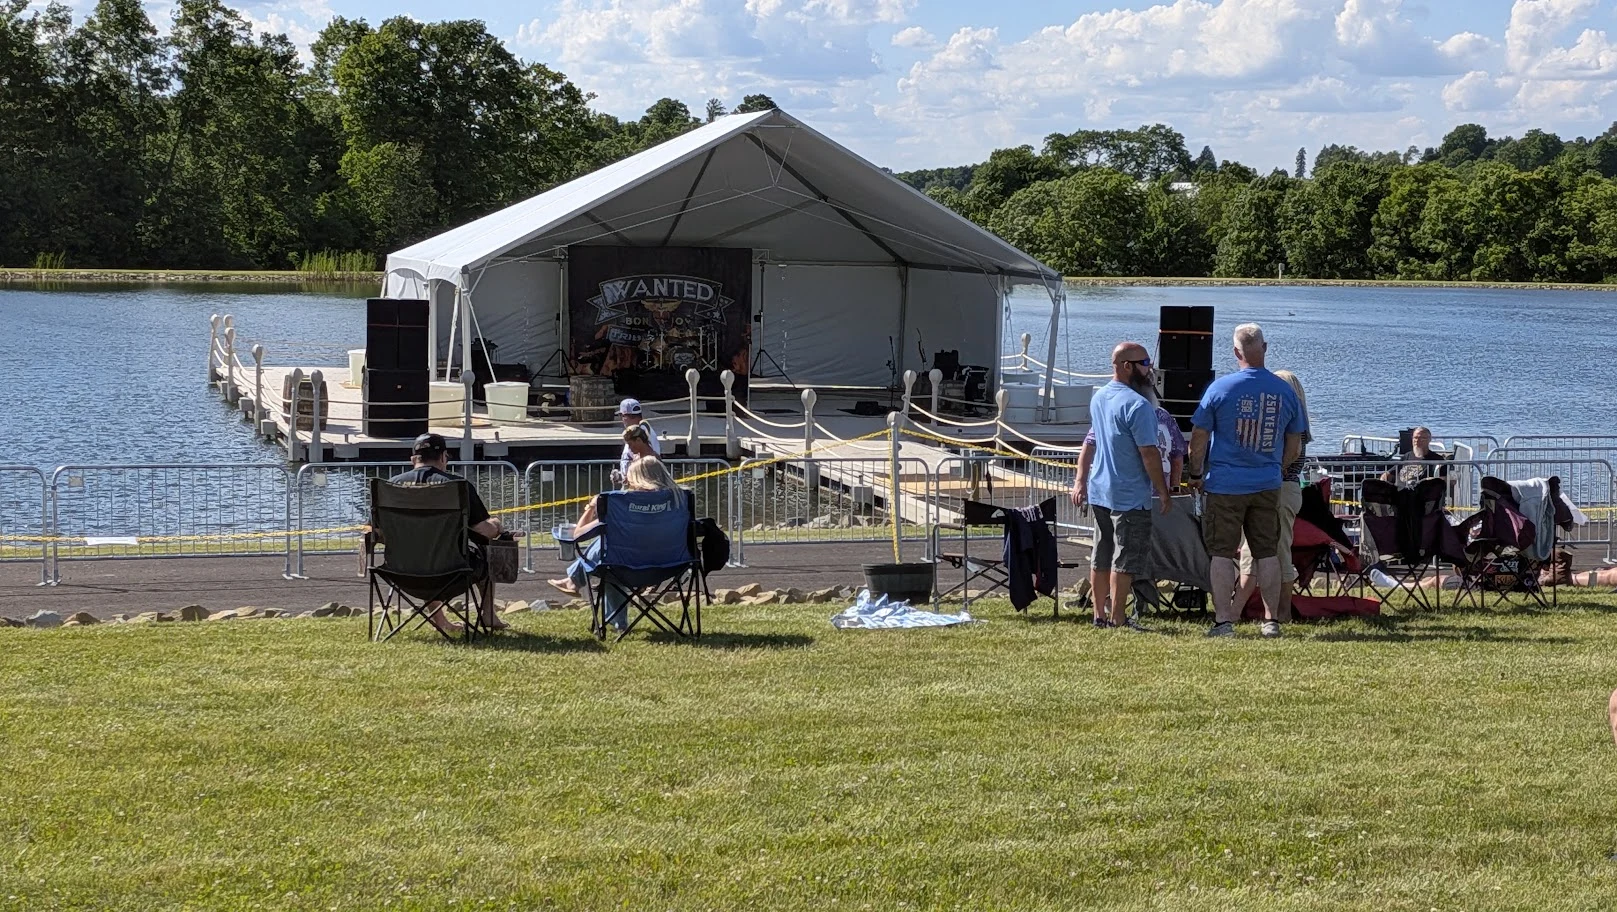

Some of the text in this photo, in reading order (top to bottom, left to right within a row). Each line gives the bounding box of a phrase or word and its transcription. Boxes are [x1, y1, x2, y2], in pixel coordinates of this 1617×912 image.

[605, 278, 714, 302] WANTED
[625, 316, 692, 326] BON JOV
[1262, 394, 1277, 447] 250 YEARS
[629, 502, 667, 512] Rural King
